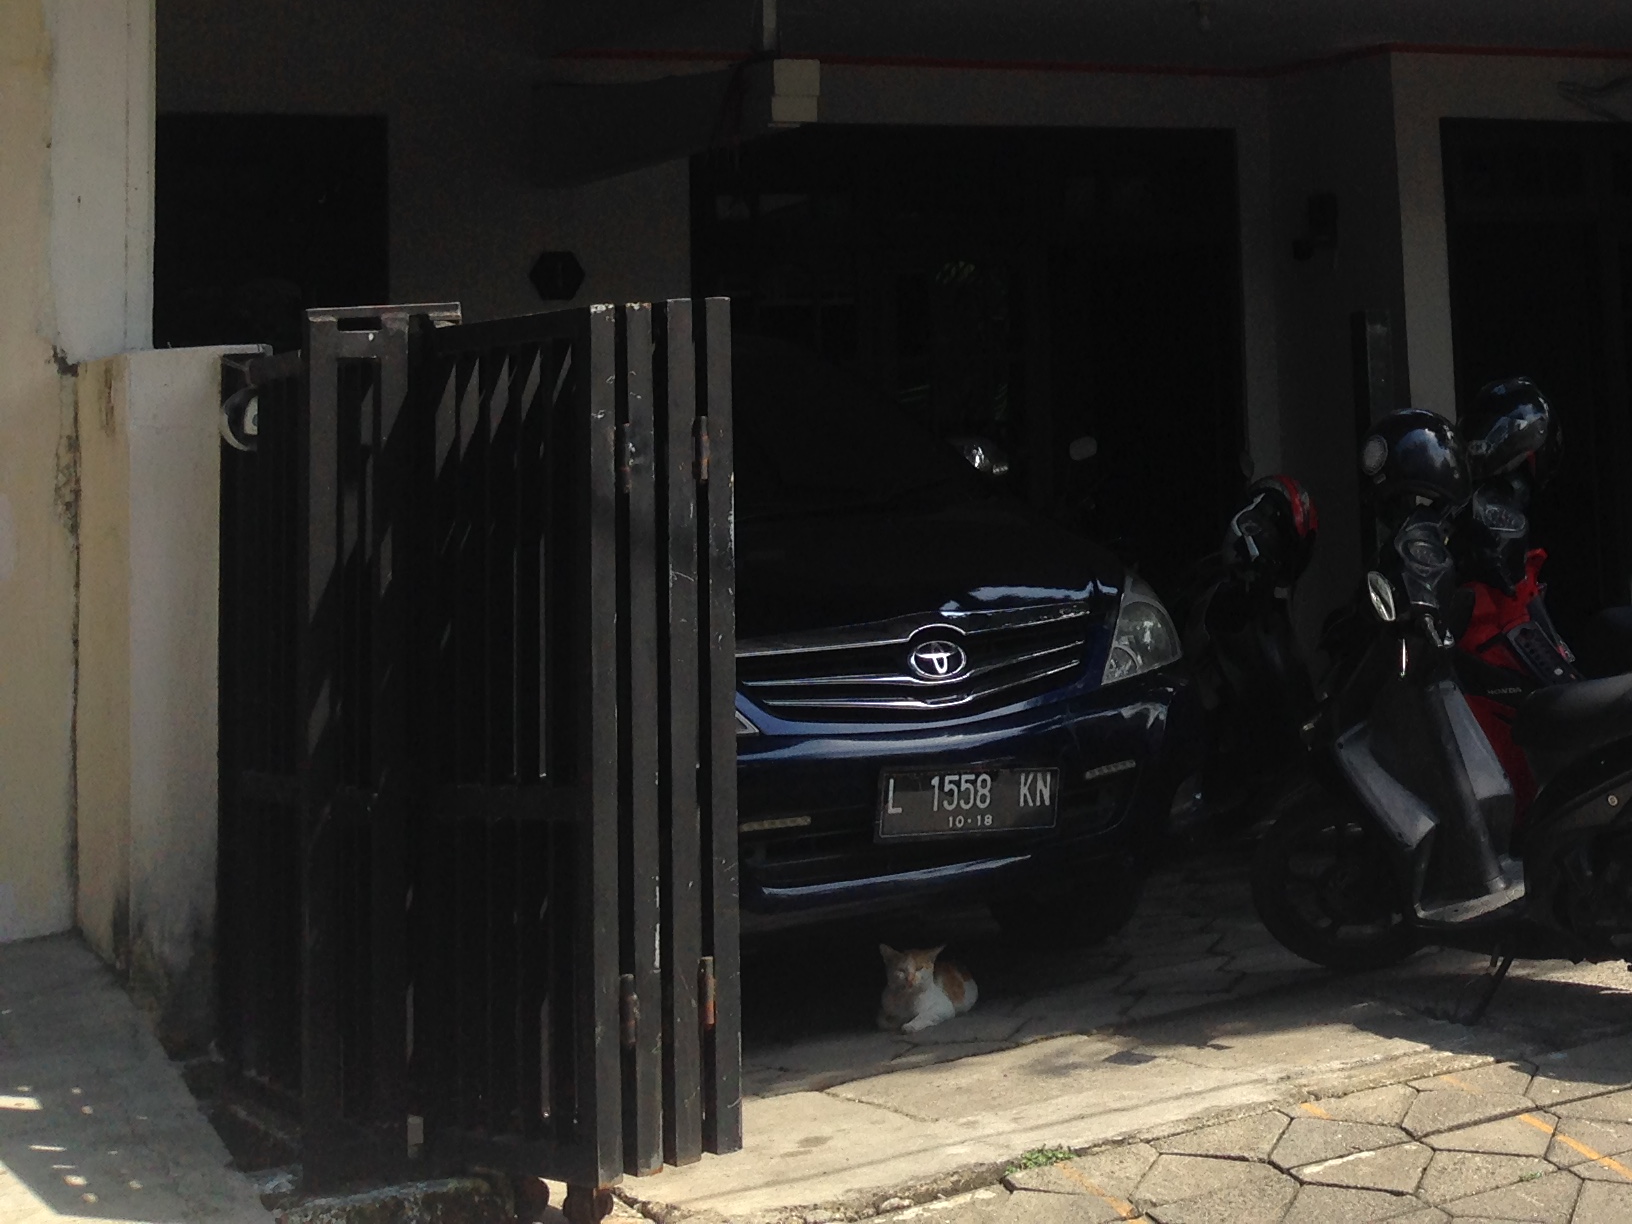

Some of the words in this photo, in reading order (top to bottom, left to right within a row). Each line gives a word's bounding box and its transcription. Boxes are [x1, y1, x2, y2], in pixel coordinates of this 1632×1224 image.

[887, 778, 903, 815] L
[931, 773, 993, 812] 1558
[1019, 772, 1052, 808] KN
